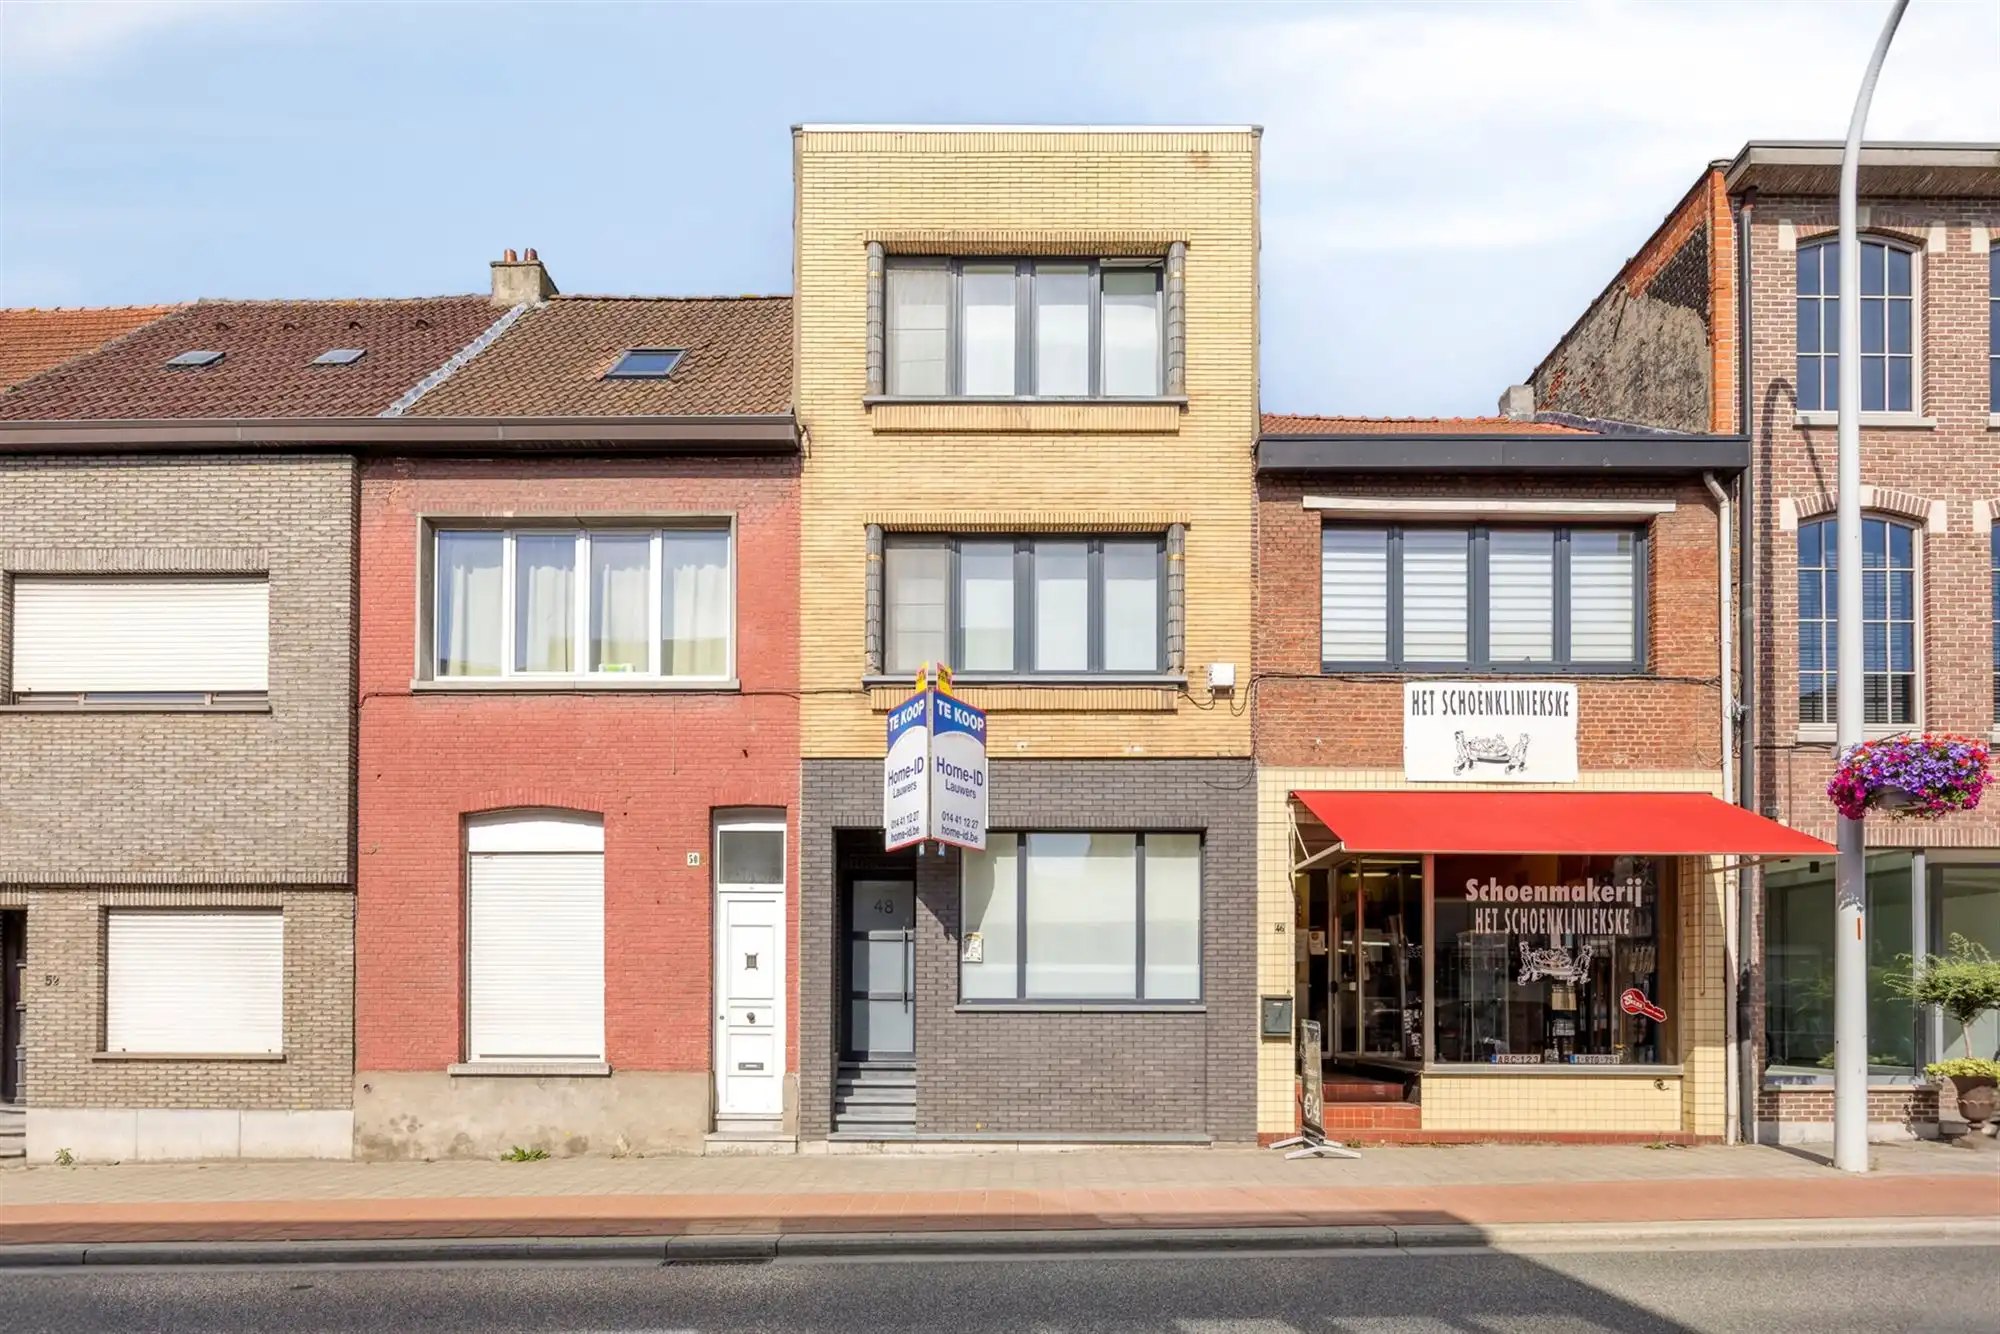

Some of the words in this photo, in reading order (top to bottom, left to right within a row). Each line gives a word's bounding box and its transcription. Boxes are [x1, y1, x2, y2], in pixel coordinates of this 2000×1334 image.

[889, 716, 899, 731] TE
[900, 699, 925, 724] KOOP
[1412, 690, 1435, 716] HET
[1442, 690, 1569, 717] SCHOENKLINIEKSKE
[937, 700, 952, 719] TE
[954, 706, 984, 732] KOOP
[888, 756, 924, 787] Home-ID
[936, 755, 984, 787] Home-ID
[892, 780, 918, 799] Lauwers
[945, 778, 977, 799] Lauwers
[941, 811, 954, 823] 014
[955, 815, 963, 825] 41
[964, 817, 970, 827] 12
[970, 819, 979, 830] 27
[890, 824, 920, 843] home-id.be
[941, 824, 979, 843] home-id.be
[688, 854, 698, 864] 50
[1465, 877, 1643, 907] Schoenmakerij
[874, 899, 893, 914] 48
[1475, 908, 1497, 934] HET
[1504, 908, 1630, 934] SCHOENKLINIEKSKE
